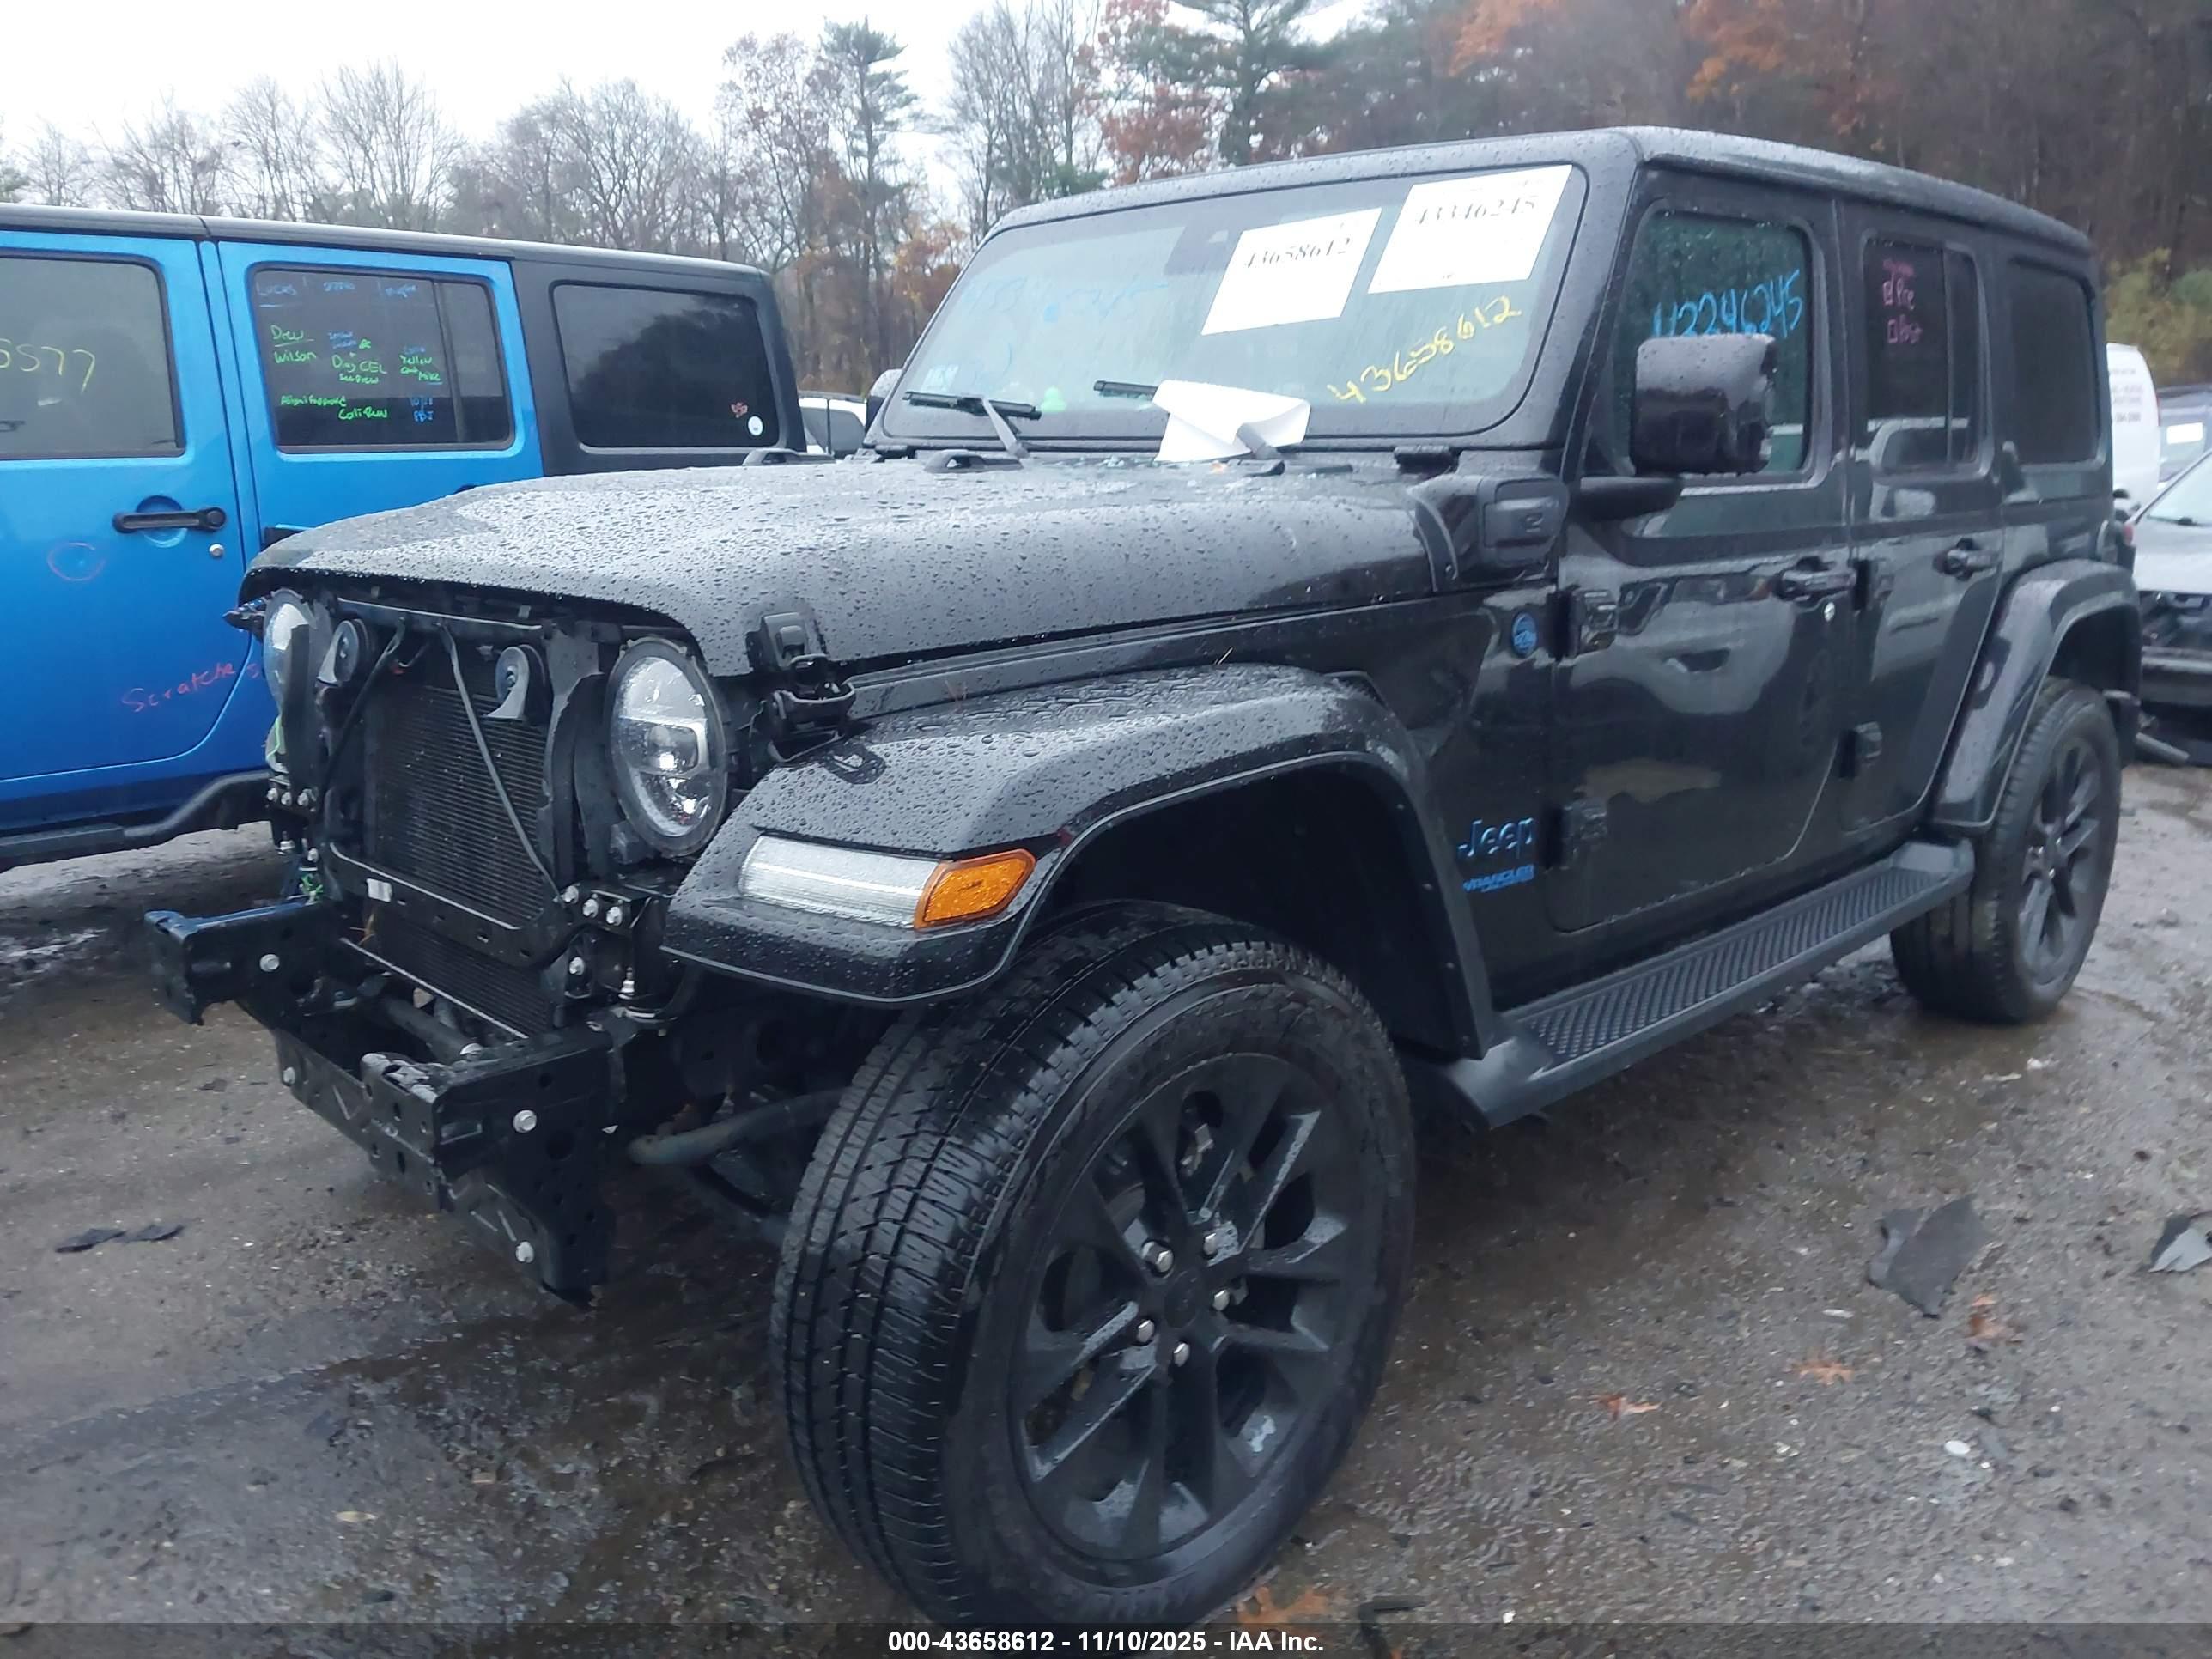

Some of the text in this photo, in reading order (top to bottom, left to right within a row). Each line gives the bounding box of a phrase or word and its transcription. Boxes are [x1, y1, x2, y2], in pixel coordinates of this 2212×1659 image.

[1243, 234, 1352, 271] 43658612
[1327, 295, 1523, 404] 43658612
[1457, 817, 1534, 860] Jeep
